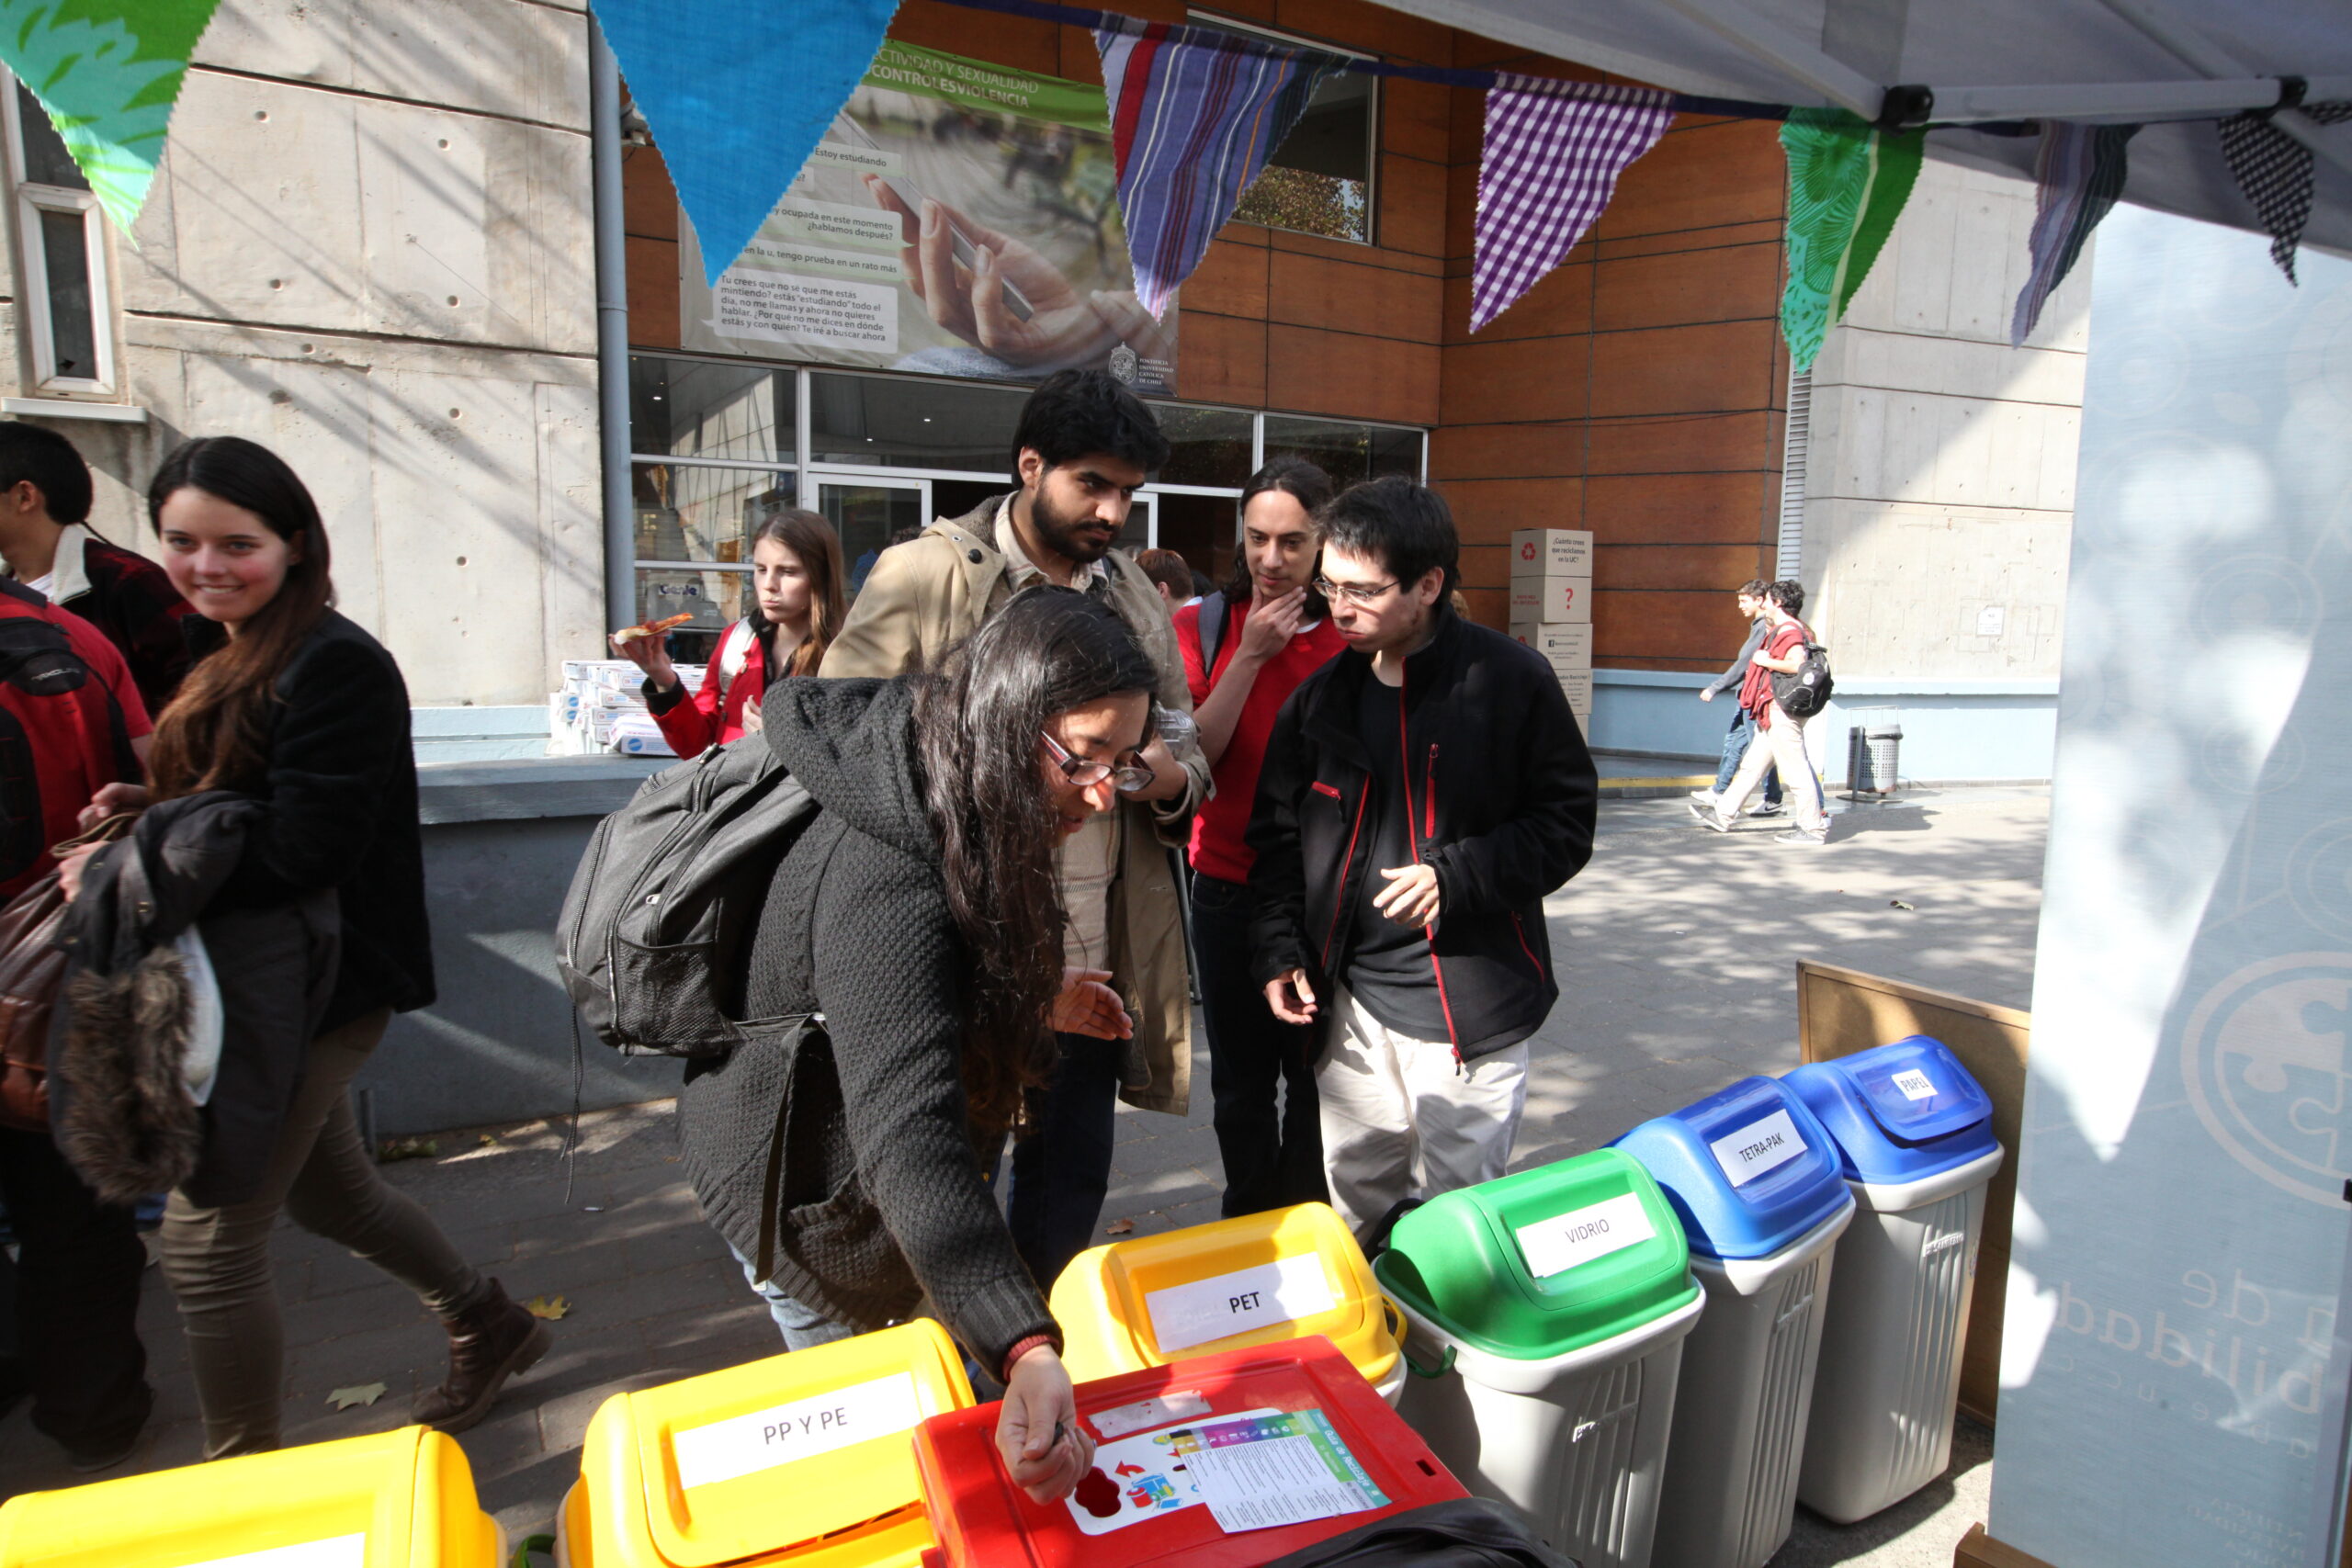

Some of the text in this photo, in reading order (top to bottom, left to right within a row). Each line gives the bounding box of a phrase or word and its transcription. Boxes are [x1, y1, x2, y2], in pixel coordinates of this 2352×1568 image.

[873, 48, 1039, 94] CTIVIDAD Y SEXUALIDAD
[815, 147, 887, 167] Estoy estudiando
[781, 208, 820, 221] ocupada
[820, 213, 831, 221] en
[833, 216, 851, 225] este
[853, 219, 893, 231] momento
[808, 221, 893, 241] ¿hablamos después?
[756, 246, 765, 256] la
[766, 249, 775, 258] u,
[777, 250, 802, 263] tengo
[804, 253, 835, 265] prueba
[837, 258, 847, 266] en
[849, 260, 860, 268] un
[862, 261, 878, 271] rato
[880, 262, 898, 274] más
[721, 275, 732, 285] Tu
[733, 277, 757, 288] crees
[759, 281, 776, 290] que
[777, 282, 789, 291] no
[801, 286, 819, 296] que
[820, 288, 833, 297] me
[720, 286, 771, 299] mintiendo?
[852, 300, 871, 311] todo
[873, 303, 881, 312] el
[740, 299, 752, 307] no
[752, 299, 767, 309] me
[769, 300, 797, 312] llamas
[798, 305, 804, 314] y
[806, 305, 830, 316] ahora
[831, 310, 842, 318] no
[844, 310, 875, 321] quieres
[720, 305, 752, 318] hablar.
[753, 310, 773, 321] ¿Por
[793, 314, 805, 322] no
[806, 316, 820, 325] me
[821, 316, 842, 327] dices
[844, 320, 854, 329] en
[746, 320, 752, 329] y
[753, 321, 769, 329] con
[802, 324, 811, 333] Te
[833, 328, 860, 339] buscar
[862, 332, 886, 342] ahora
[1561, 547, 1586, 555] reciclamos
[1900, 1077, 1929, 1091] PAPEL
[1738, 1132, 1784, 1163] TETRA-PAK
[1565, 1218, 1610, 1244] VIDRIO
[1229, 1291, 1260, 1314] PET
[763, 1407, 848, 1445] PP Y PE
[1336, 1447, 1345, 1455] de
[1343, 1456, 1371, 1486] Reciclaje
